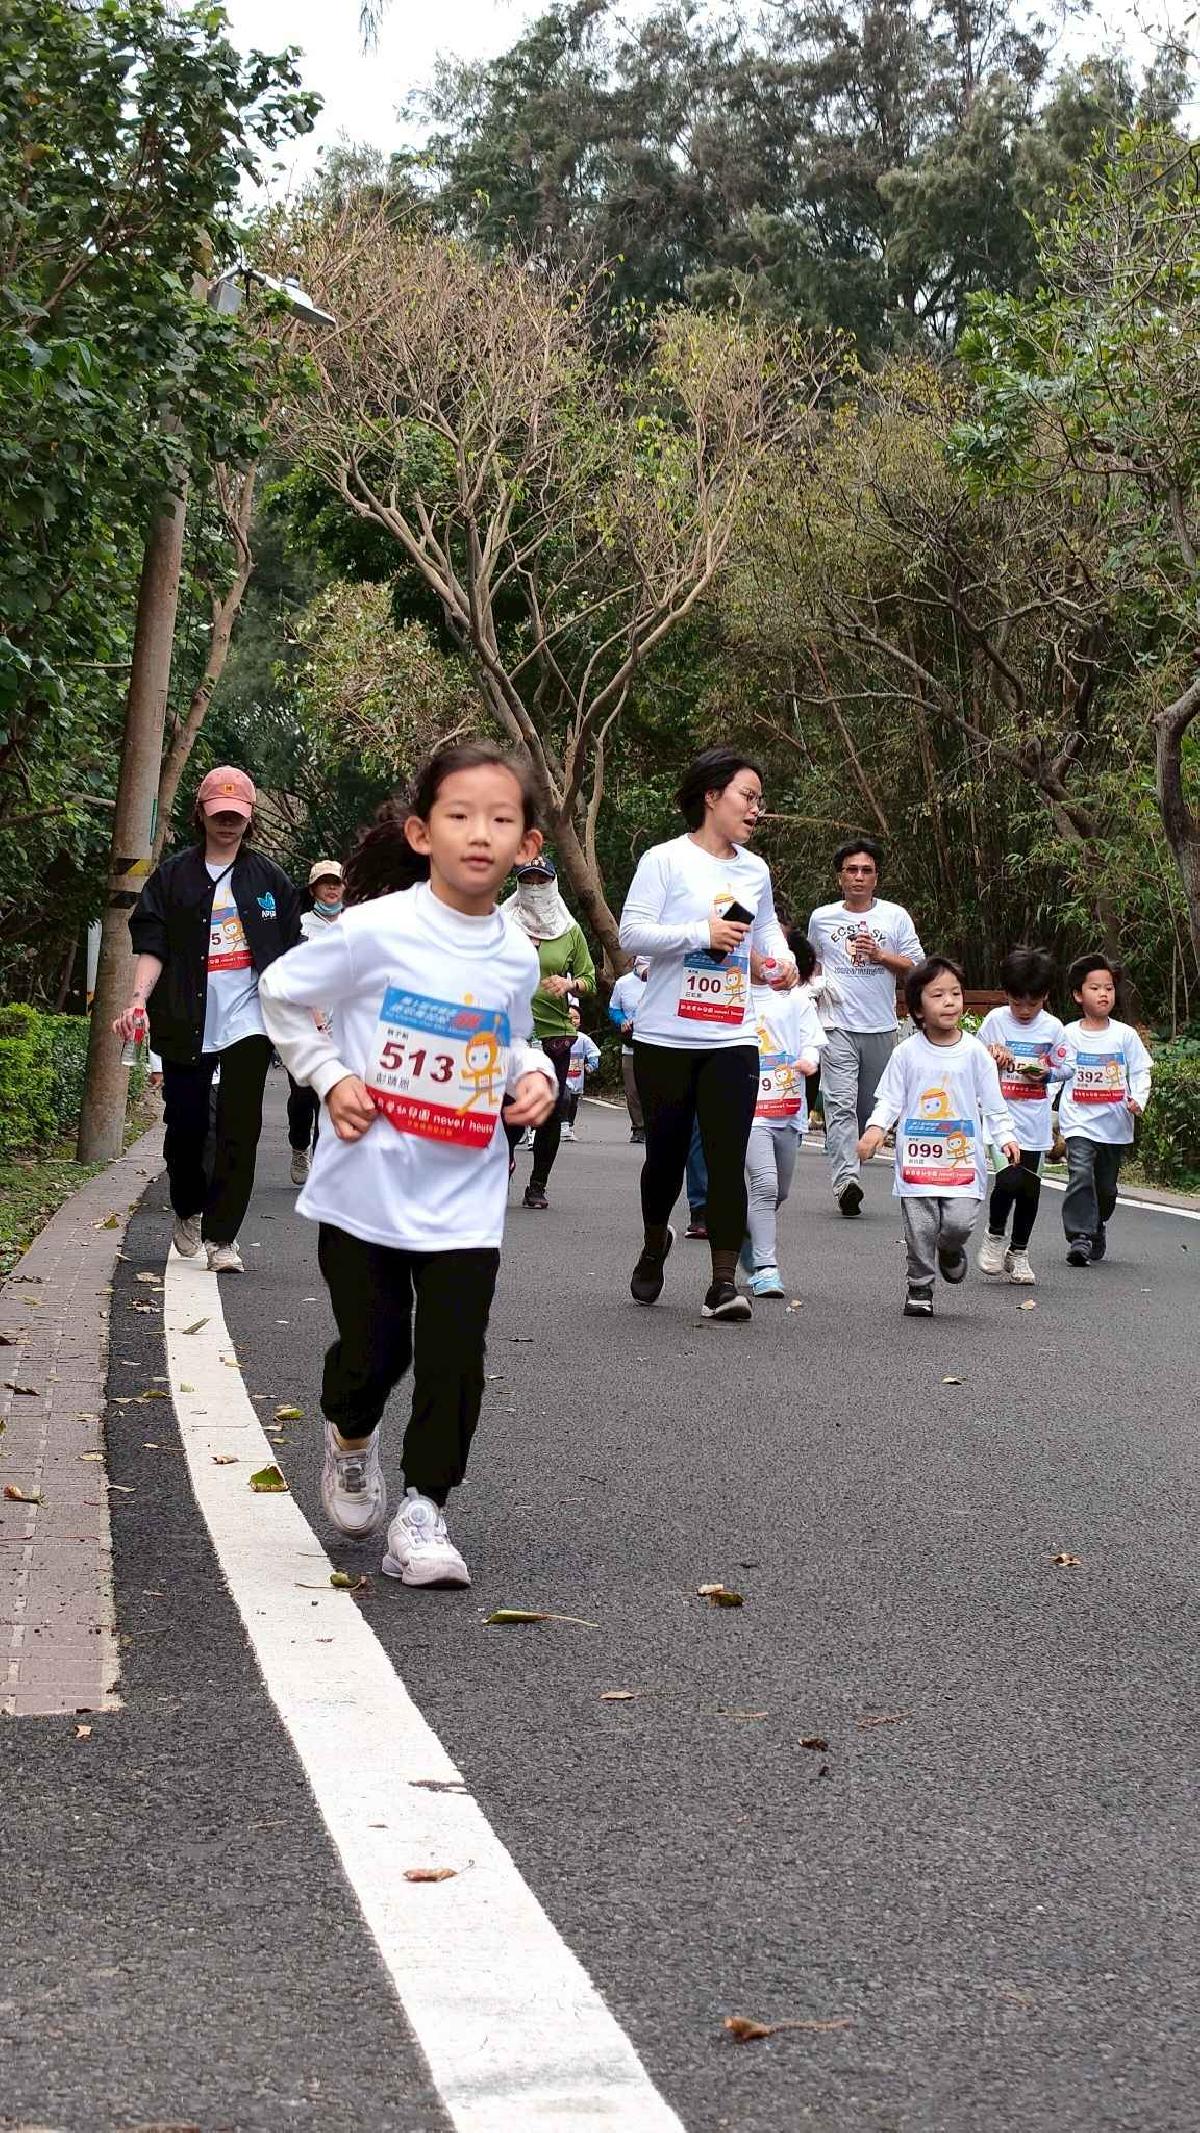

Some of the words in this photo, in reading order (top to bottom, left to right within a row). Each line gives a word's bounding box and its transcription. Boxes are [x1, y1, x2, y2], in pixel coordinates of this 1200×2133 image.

[831, 924, 887, 943] ECSTSY
[687, 975, 721, 993] 100
[379, 1041, 455, 1083] 513
[1077, 1070, 1103, 1083] 392
[908, 1143, 943, 1158] 099
